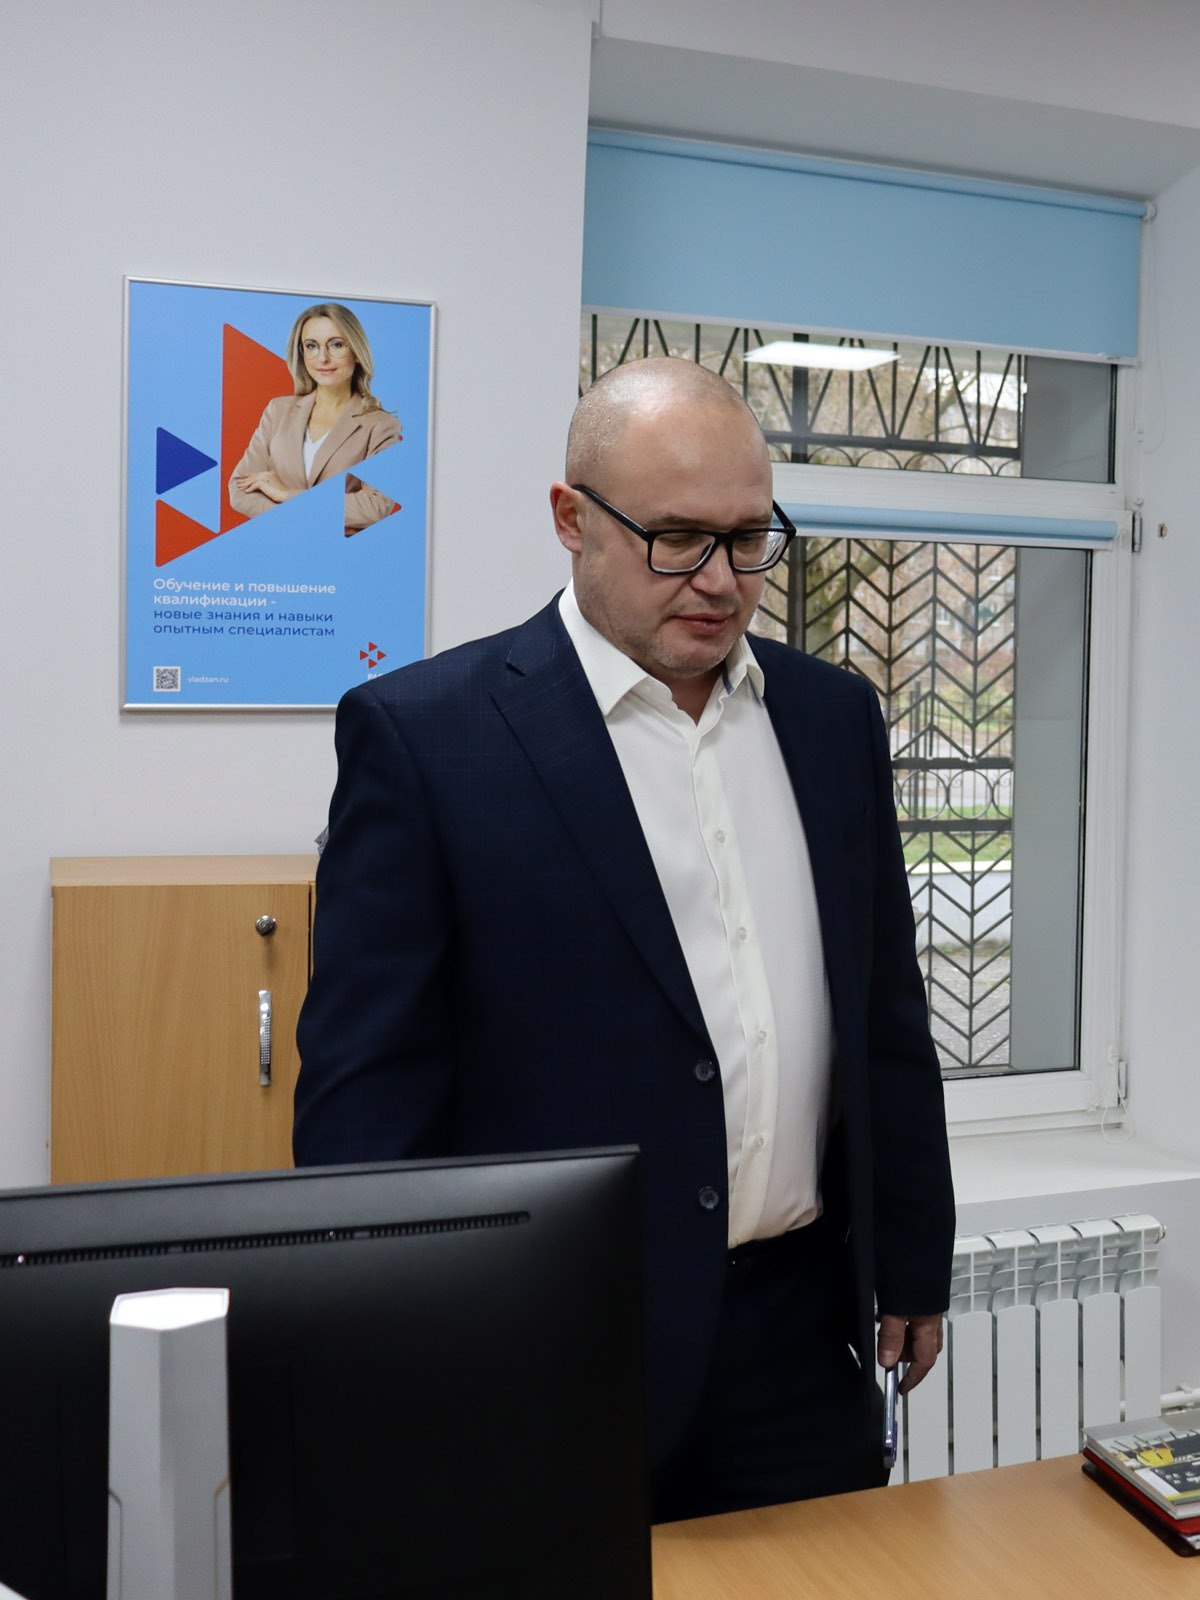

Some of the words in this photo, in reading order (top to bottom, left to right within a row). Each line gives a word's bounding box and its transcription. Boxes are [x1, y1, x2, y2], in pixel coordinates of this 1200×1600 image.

[153, 578, 231, 592] Обучение
[234, 582, 244, 591] и
[248, 582, 336, 594] повышение
[153, 593, 267, 608] квалификации
[153, 610, 202, 620] новые
[207, 610, 261, 621] знания
[265, 612, 274, 621] и
[278, 612, 333, 622] навыки
[153, 623, 224, 635] опытным
[228, 625, 335, 637] специалистам
[187, 675, 229, 684] vladzan.ru
